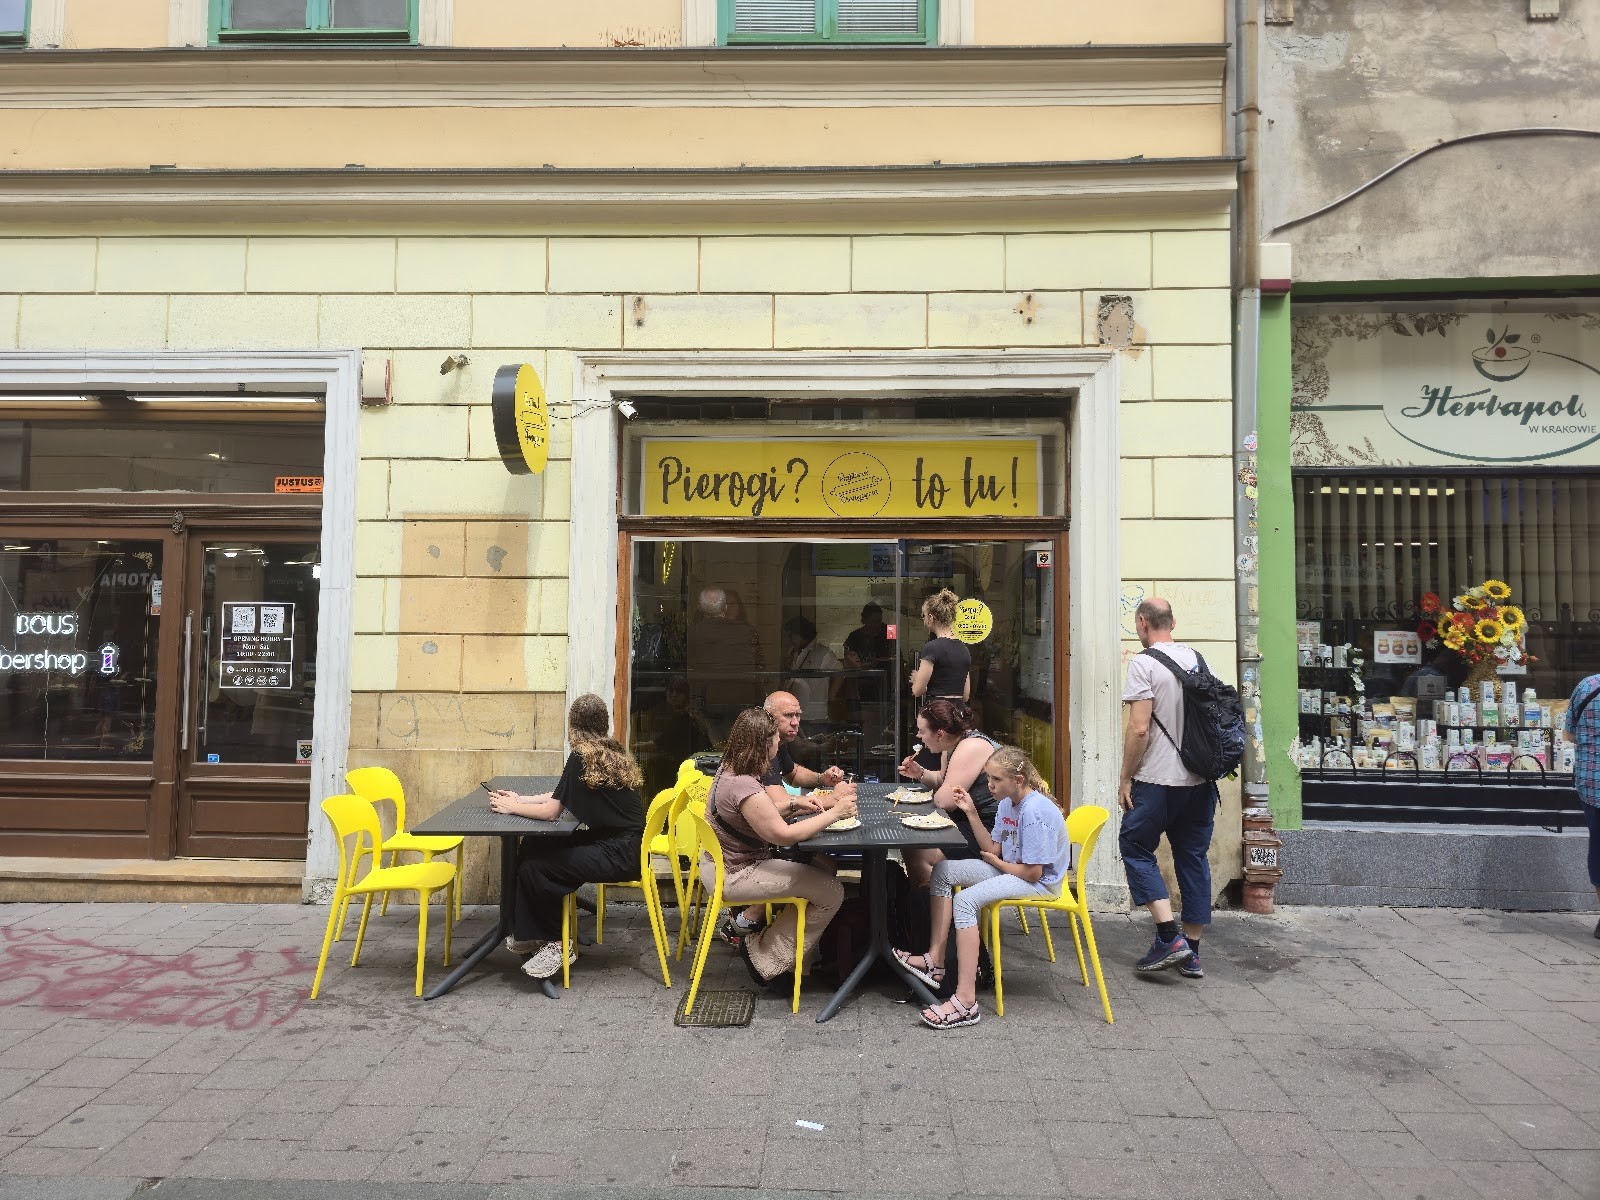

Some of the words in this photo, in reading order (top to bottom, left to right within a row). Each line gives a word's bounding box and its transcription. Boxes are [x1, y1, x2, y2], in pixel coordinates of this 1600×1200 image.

[1401, 385, 1587, 425] Herbapol
[1529, 425, 1541, 434] W
[1542, 425, 1597, 434] KRAKOWIE
[276, 478, 314, 487] JUSTUS
[658, 456, 809, 517] Pierogi?
[911, 457, 951, 509] to
[16, 614, 74, 635] BOUS
